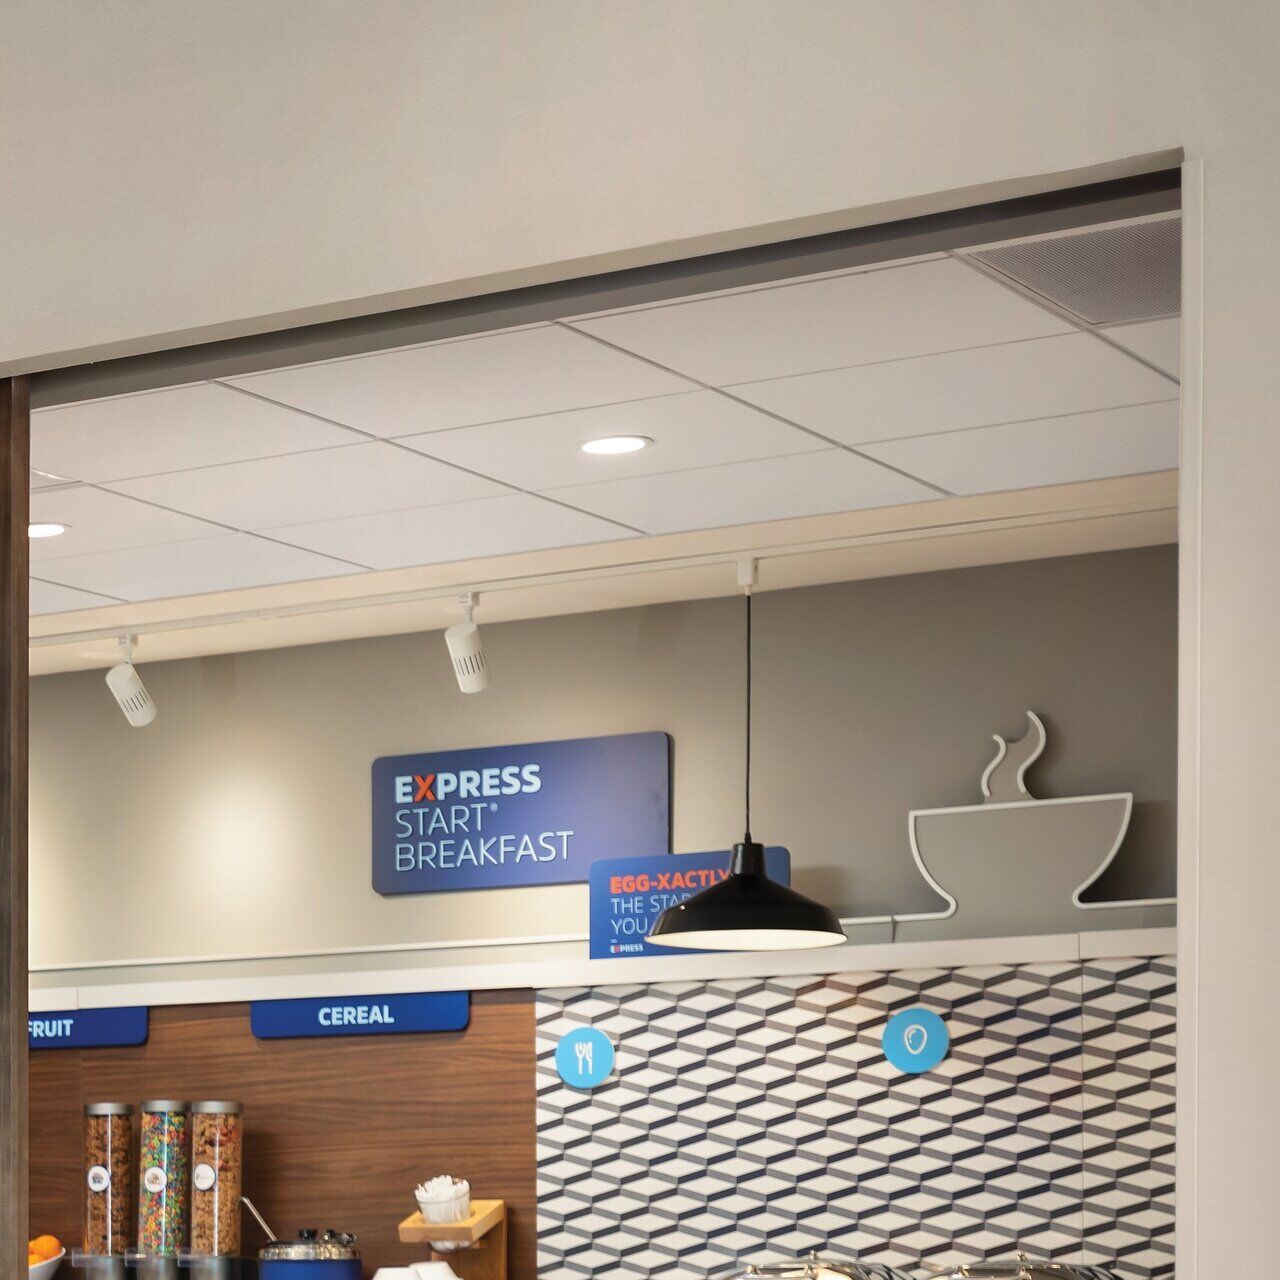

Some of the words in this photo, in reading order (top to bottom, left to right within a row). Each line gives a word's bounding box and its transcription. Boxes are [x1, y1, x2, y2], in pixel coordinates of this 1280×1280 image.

[395, 763, 542, 805] EXPRESS
[395, 830, 575, 872] BREAKFAST
[610, 896, 645, 915] THE
[610, 916, 649, 935] YOU
[610, 943, 644, 954] EXPRESS
[318, 1004, 395, 1026] CEREAL
